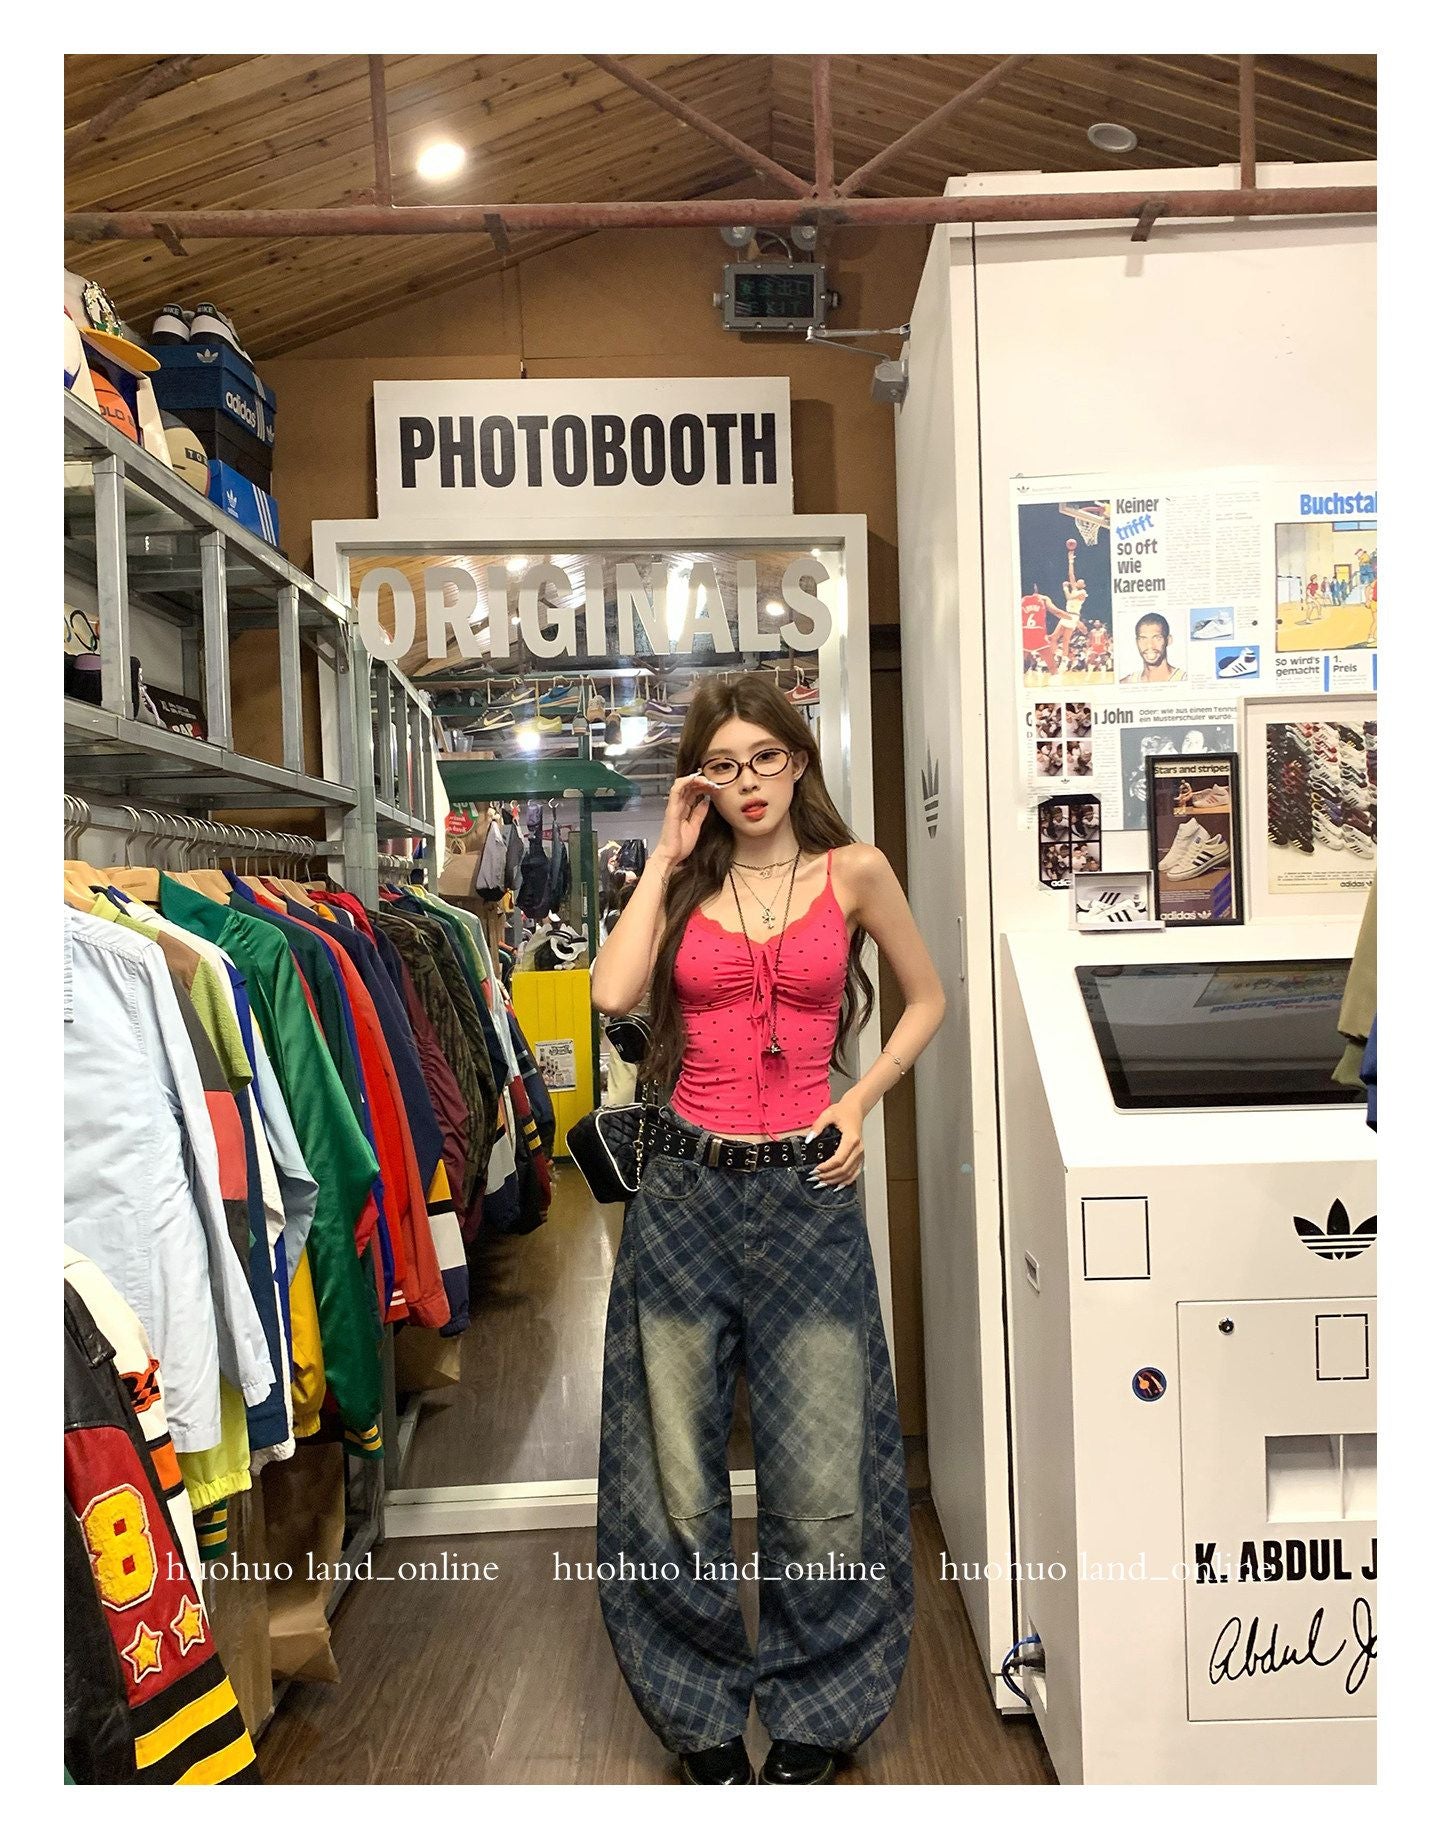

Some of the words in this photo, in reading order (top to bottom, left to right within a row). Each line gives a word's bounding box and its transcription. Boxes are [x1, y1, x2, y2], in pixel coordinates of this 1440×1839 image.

[224, 390, 258, 428] adidas
[399, 412, 778, 489] PHOTOBOOTH
[1116, 498, 1160, 514] Keiner
[1116, 513, 1155, 540] trifft
[1117, 543, 1132, 556] so
[1135, 538, 1158, 555] oft
[1117, 557, 1142, 574] wie
[1114, 577, 1166, 594] Kareem
[358, 558, 834, 661] ORIGINALS
[1027, 613, 1037, 627] 6
[1290, 656, 1320, 665] wird's
[1333, 655, 1342, 663] 1.
[1275, 665, 1320, 677] gemacht
[1333, 663, 1358, 673] Preis
[1101, 708, 1134, 725] John
[1189, 706, 1212, 714] einem
[1154, 766, 1177, 776] Stars
[1179, 765, 1196, 774] and
[1197, 764, 1230, 775] stripes
[1160, 910, 1196, 920] adidas
[79, 1483, 159, 1611] 8
[1195, 1543, 1229, 1584] K.
[1238, 1539, 1352, 1582] ABDUL
